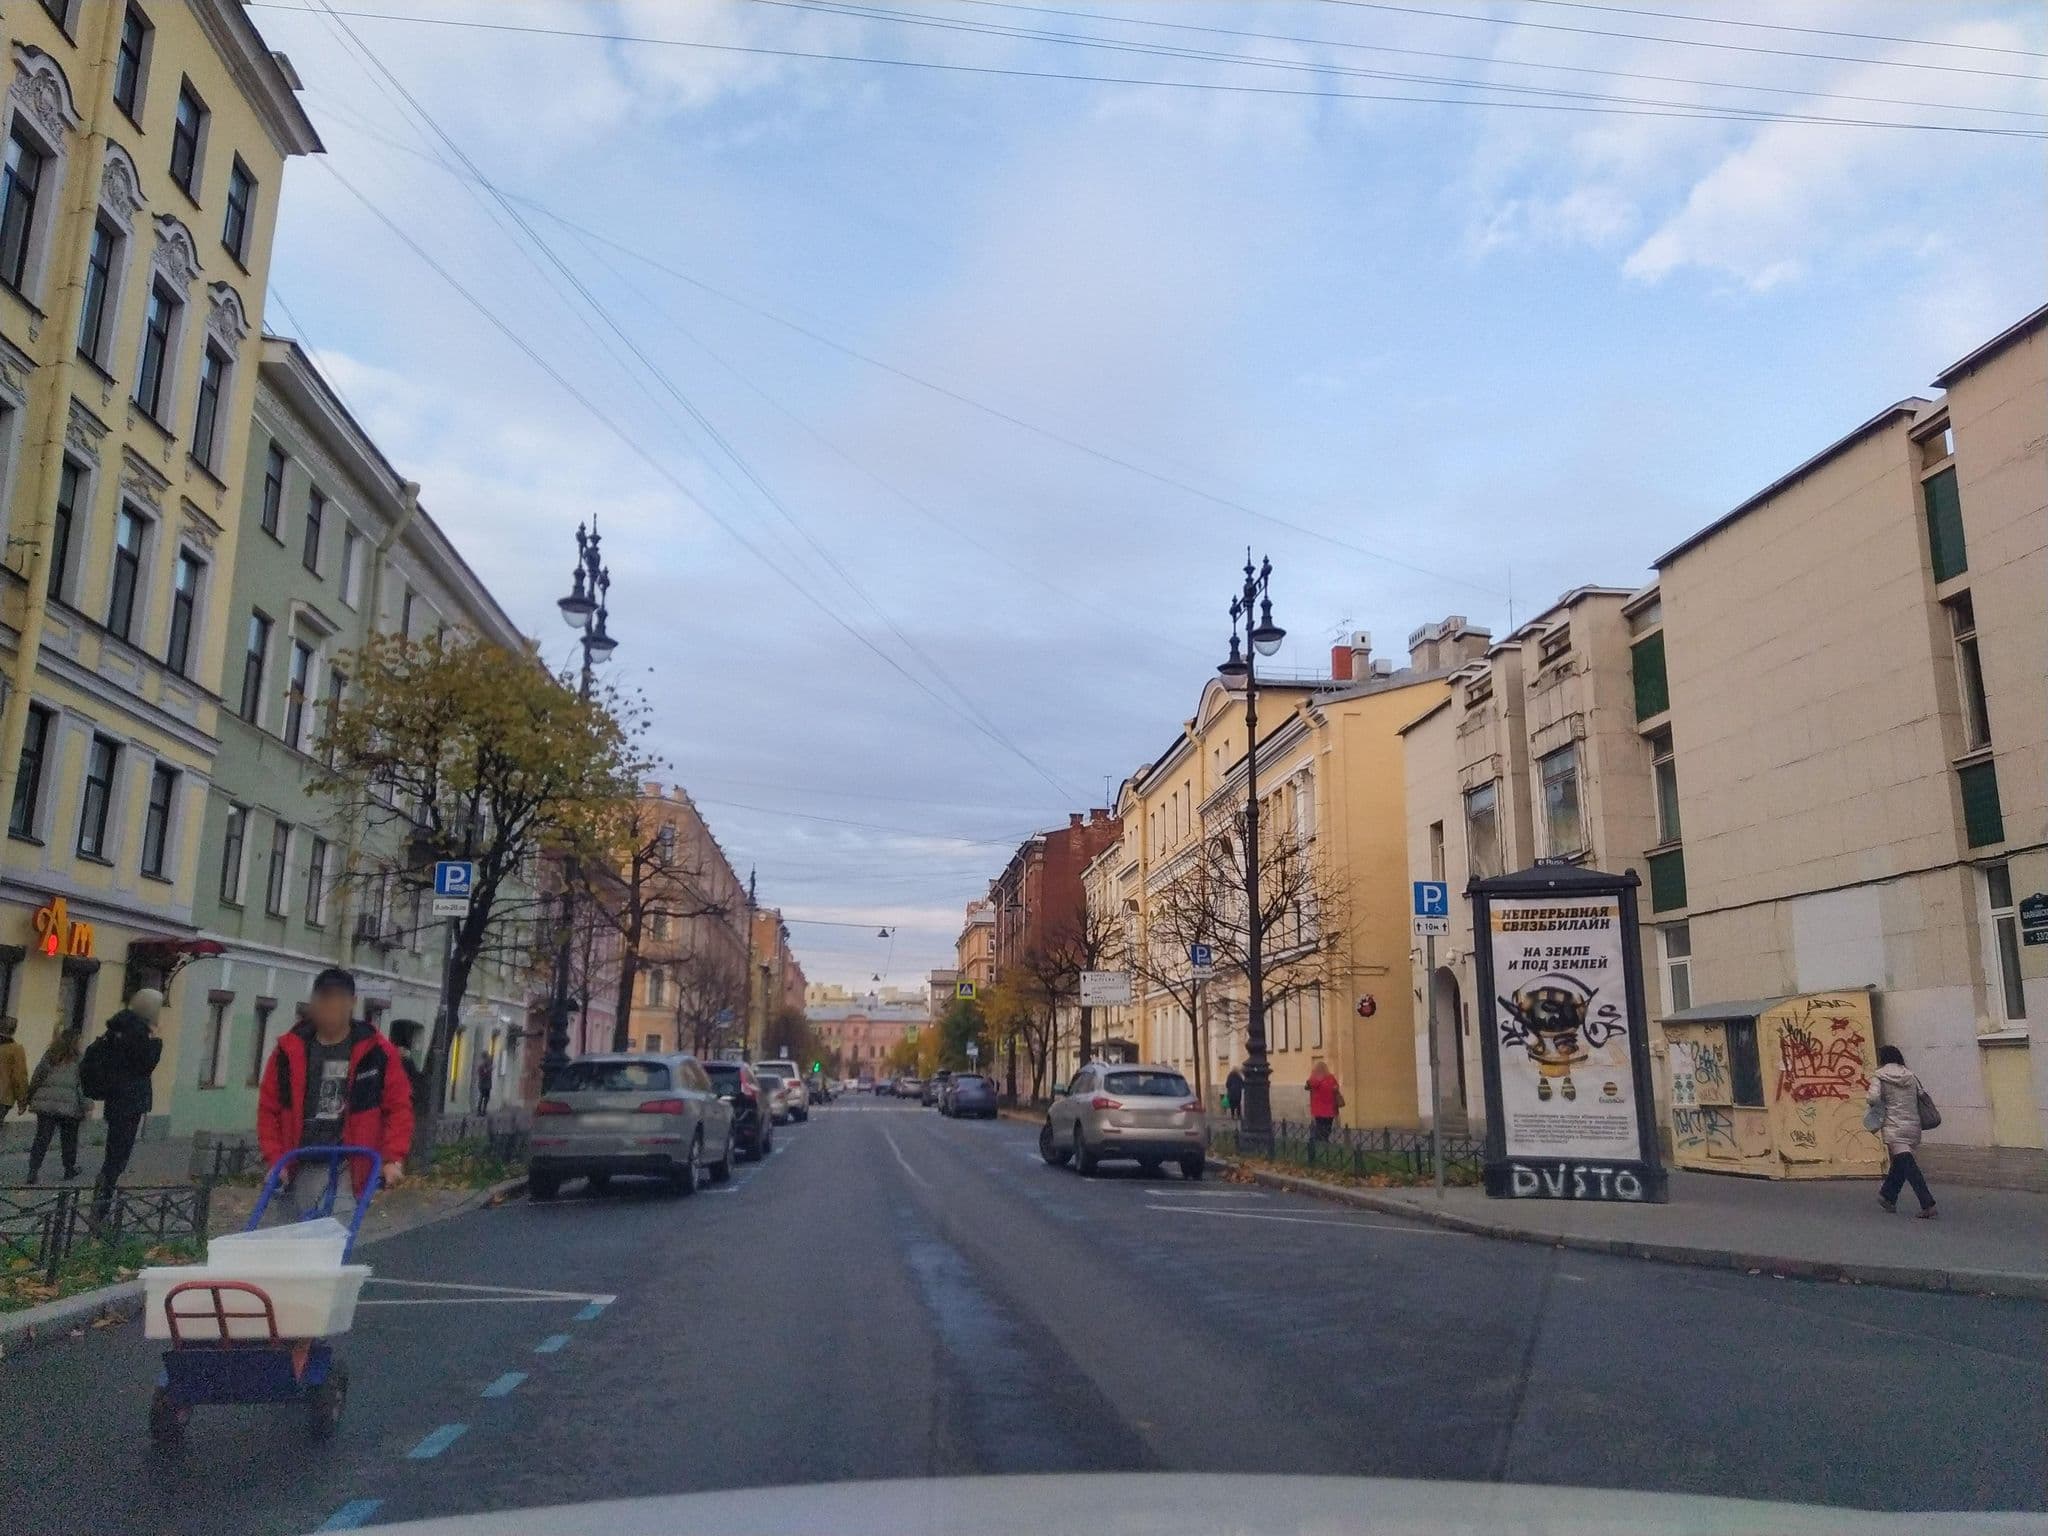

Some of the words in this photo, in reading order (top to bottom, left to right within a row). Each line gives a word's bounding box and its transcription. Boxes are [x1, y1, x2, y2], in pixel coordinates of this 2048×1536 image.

[445, 866, 465, 891] P
[1423, 885, 1442, 912] P
[1501, 906, 1610, 920] НЕПРЕРЫВНАЯ
[1196, 946, 1208, 964] P
[1523, 947, 1541, 957] НА
[1545, 946, 1590, 957] ЗЕМЛЕ
[1508, 960, 1518, 970] И
[1521, 960, 1548, 971] ПОД
[1552, 955, 1608, 970] ЗЕМЛЕЙ
